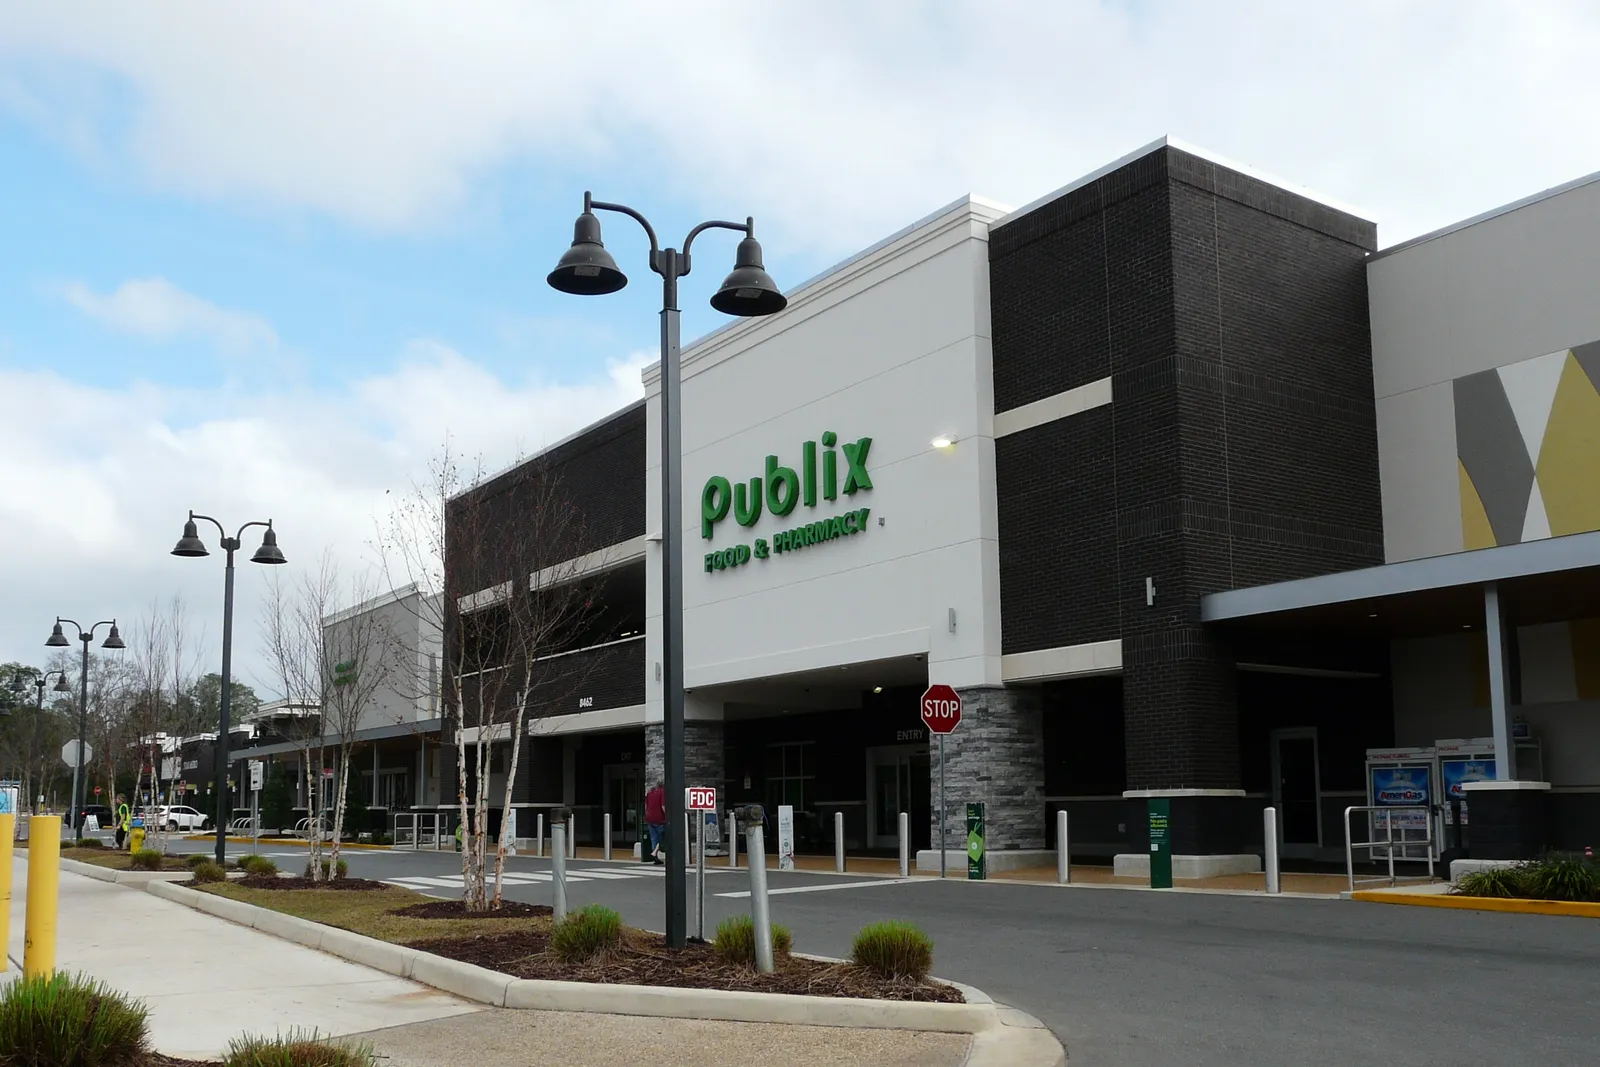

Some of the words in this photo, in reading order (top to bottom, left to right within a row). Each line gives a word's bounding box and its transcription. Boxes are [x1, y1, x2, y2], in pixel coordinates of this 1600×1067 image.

[704, 544, 751, 573] FOOD
[753, 538, 770, 559] &
[773, 508, 871, 554] PHARMACY
[579, 696, 593, 708] 8462
[924, 699, 959, 718] STOP
[897, 729, 924, 741] ENTRY
[690, 791, 714, 806] FDC
